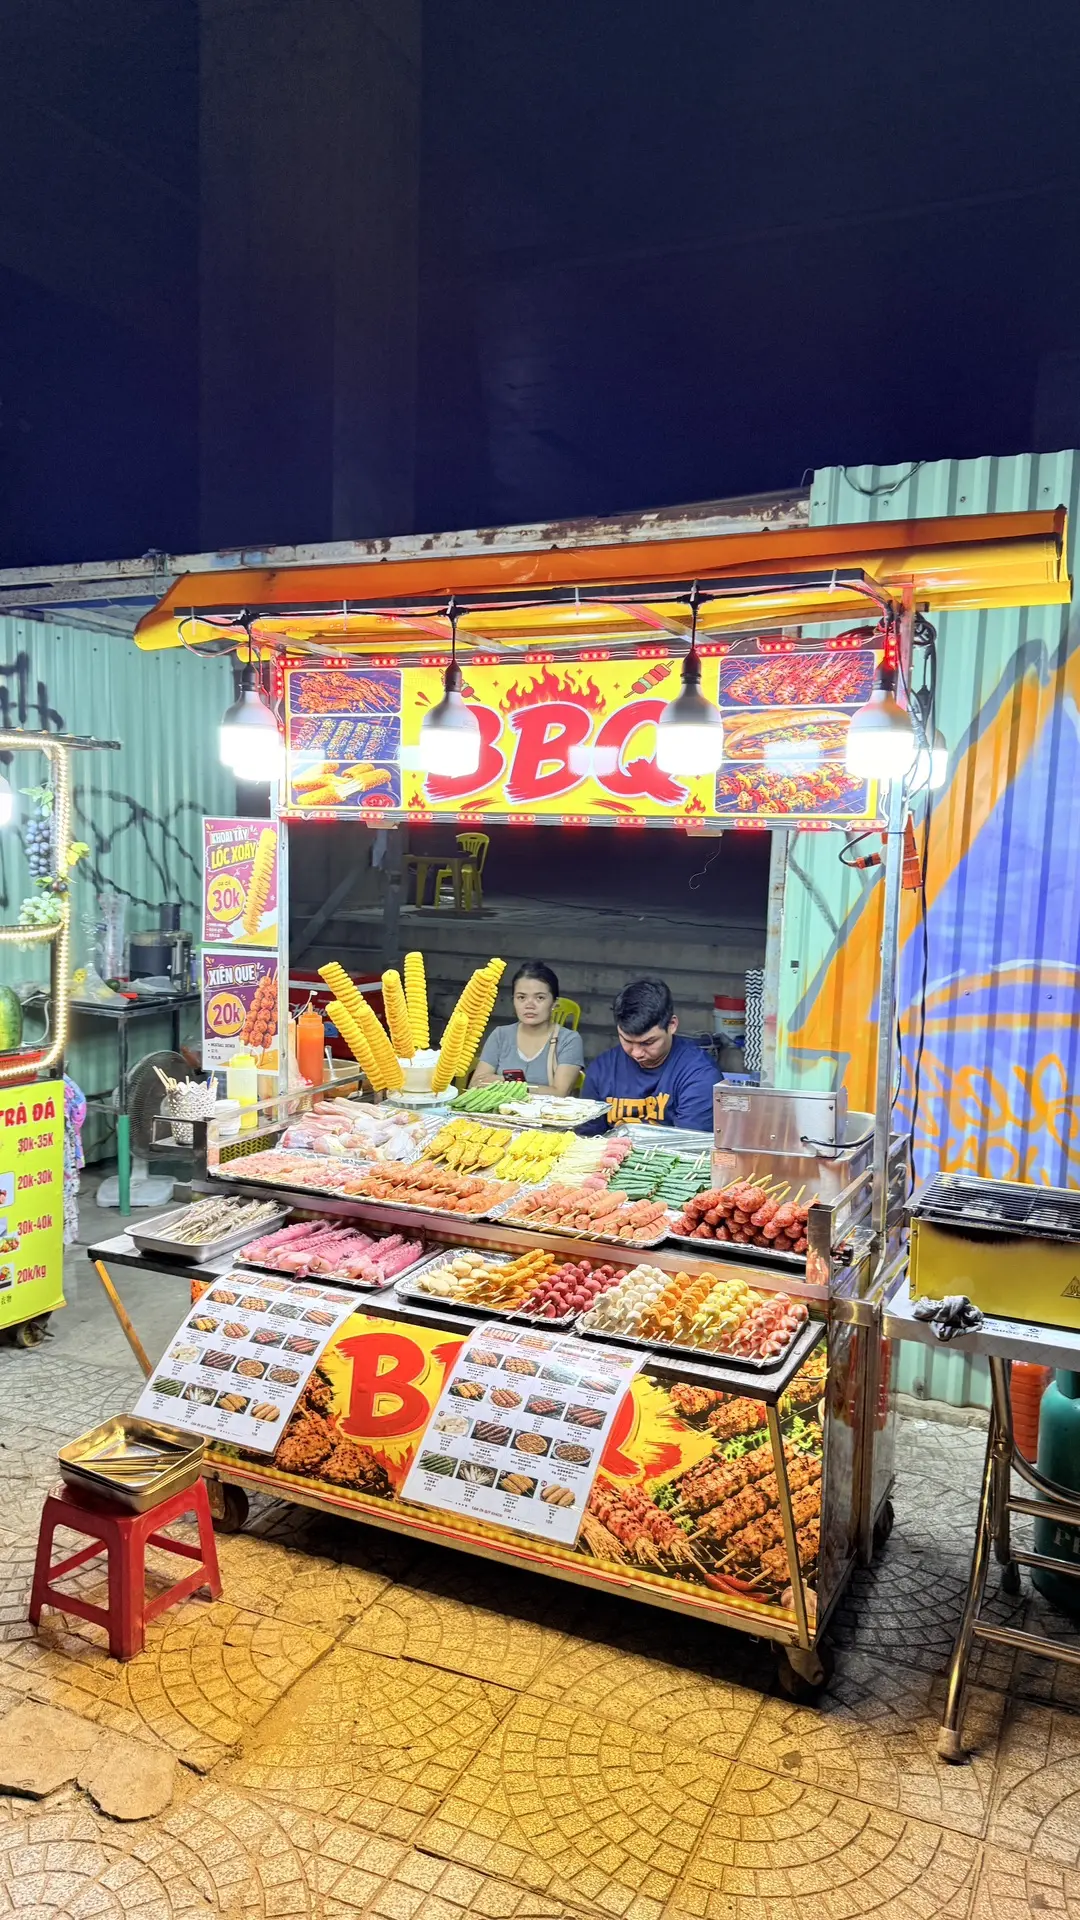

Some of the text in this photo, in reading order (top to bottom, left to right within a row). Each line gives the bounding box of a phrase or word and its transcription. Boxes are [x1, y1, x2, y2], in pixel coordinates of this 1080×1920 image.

[423, 698, 690, 805] BBQ
[211, 827, 249, 844] KHOAI TÂY
[213, 887, 240, 912] 30k
[208, 965, 256, 986] XIÊN QUE
[212, 1003, 240, 1025] 20k
